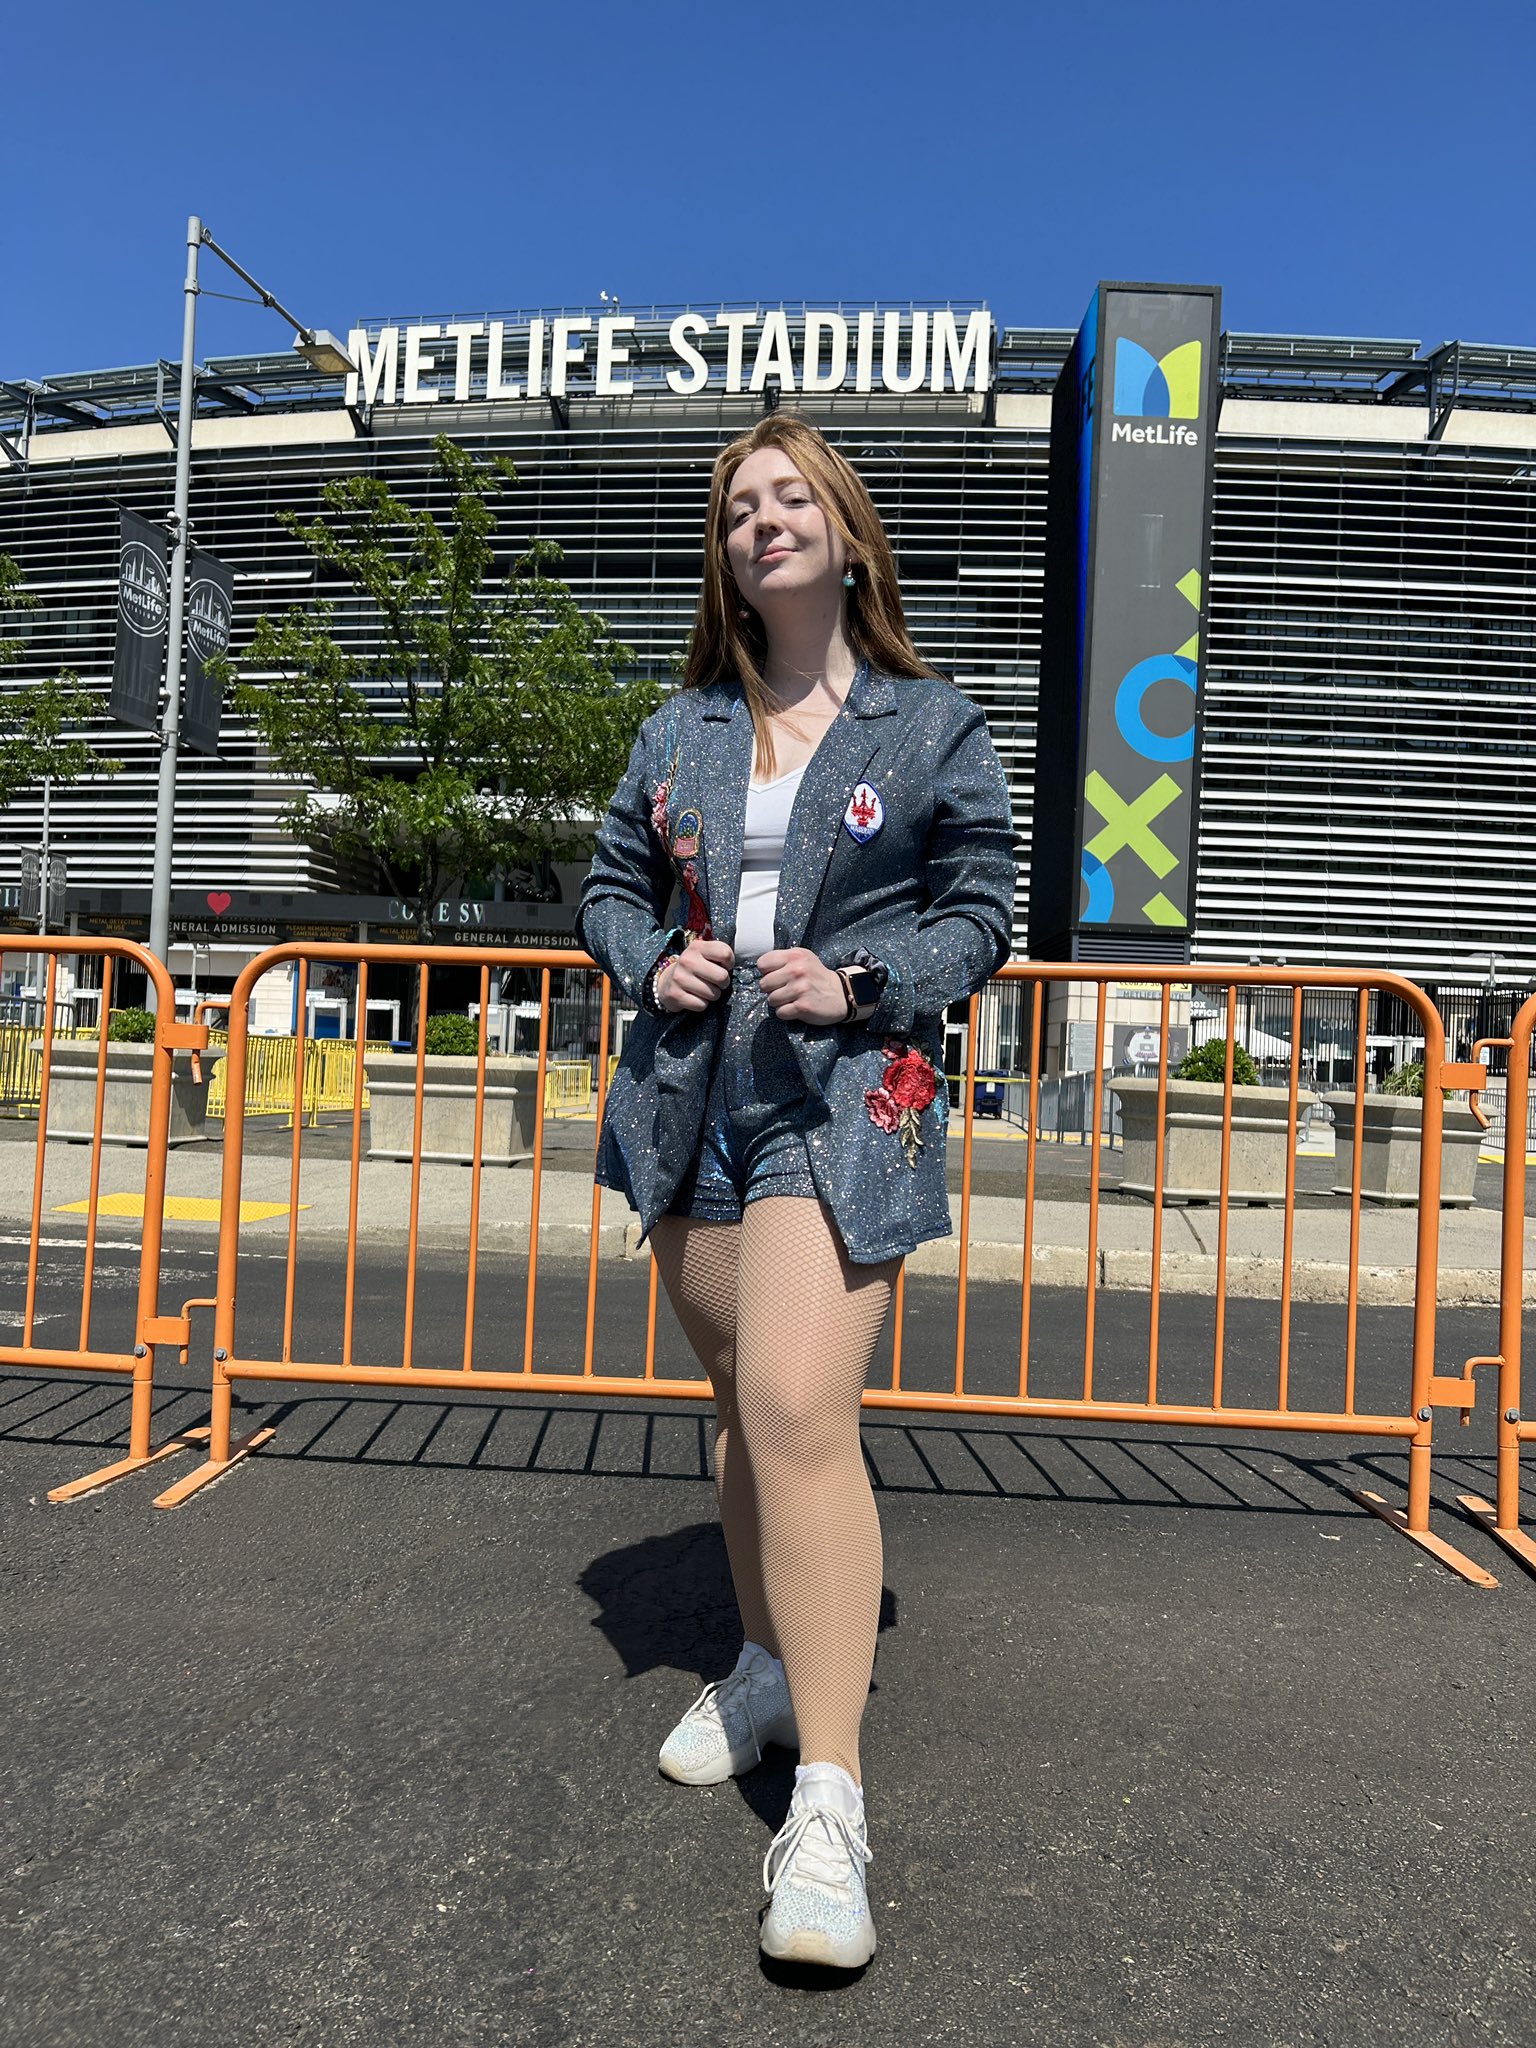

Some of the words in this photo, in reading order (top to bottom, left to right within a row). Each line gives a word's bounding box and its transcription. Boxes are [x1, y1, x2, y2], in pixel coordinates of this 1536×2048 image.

[345, 316, 636, 406] METLIFE
[665, 310, 992, 395] STADIUM
[1111, 422, 1198, 446] MetLife
[123, 585, 163, 615] MetLife
[193, 620, 226, 646] MetLife
[168, 921, 209, 932] ENERAL
[213, 923, 276, 935] ADMISSION
[454, 931, 509, 944] GENERAL
[513, 932, 579, 947] ADMISSION
